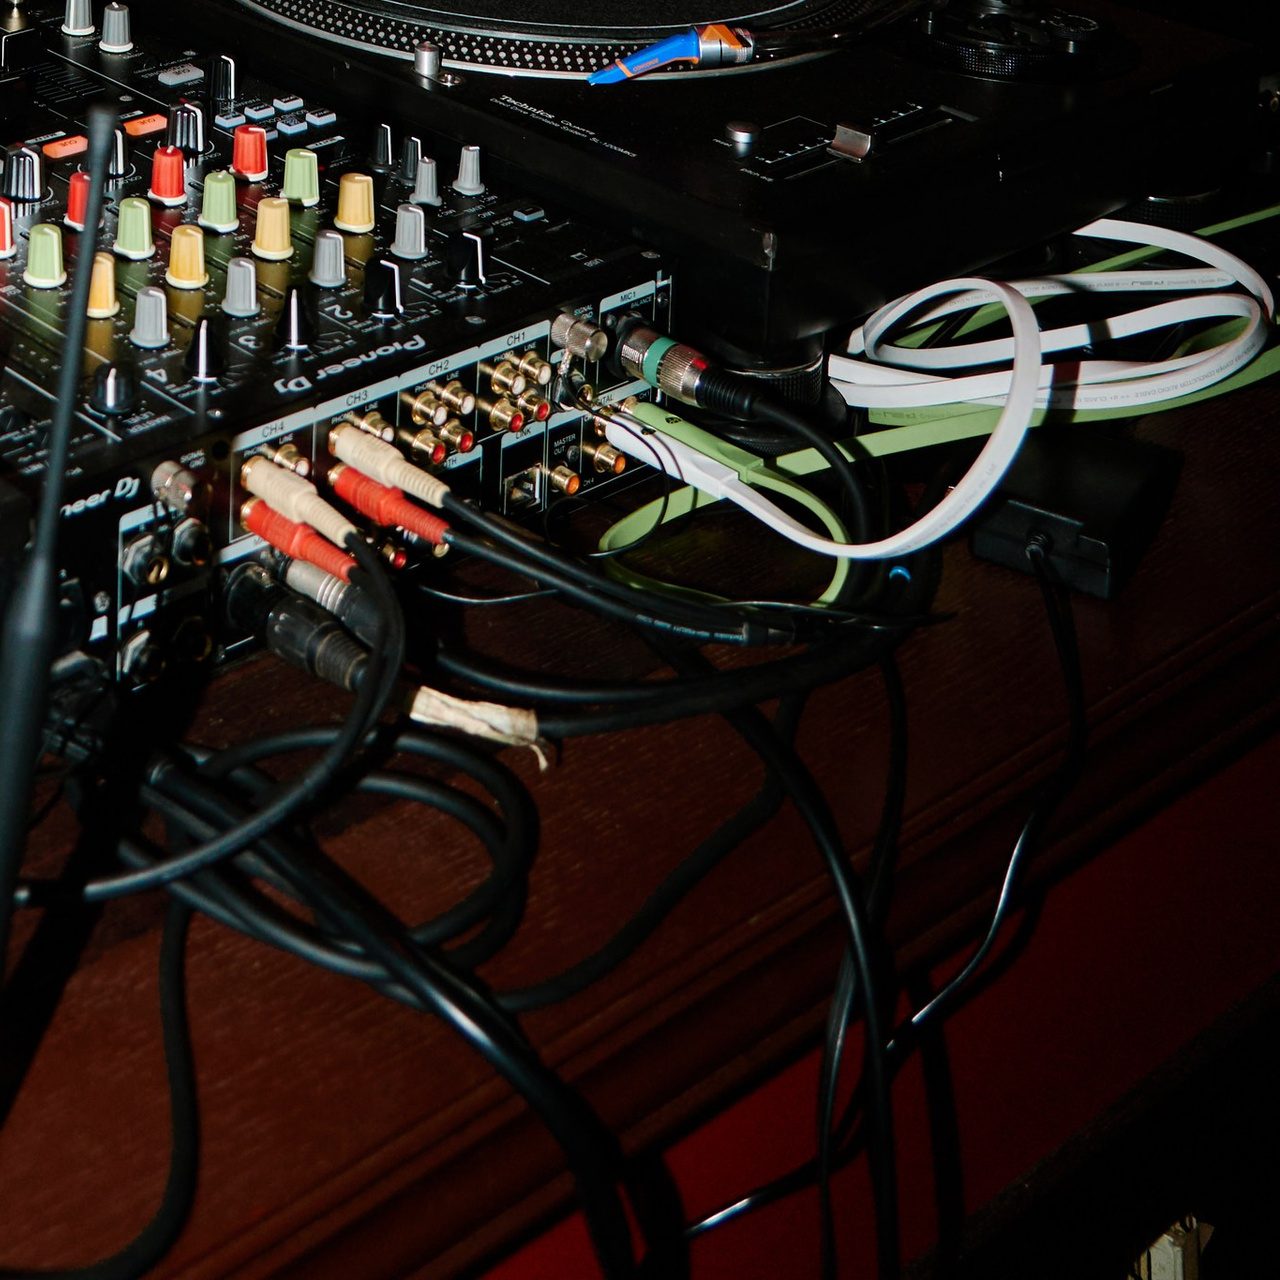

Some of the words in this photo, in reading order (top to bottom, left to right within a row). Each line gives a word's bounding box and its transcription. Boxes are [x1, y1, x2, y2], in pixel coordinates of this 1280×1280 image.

[137, 117, 156, 126] CUE
[58, 139, 77, 148] CUE
[630, 296, 652, 309] BALANCE
[324, 304, 353, 319] 2
[574, 304, 593, 317] SIGNAL
[238, 335, 263, 349] 3
[506, 332, 525, 346] CH1
[524, 341, 537, 351] LINE
[316, 335, 426, 381] Pioneer
[494, 350, 514, 362] PHONO
[428, 360, 449, 376] CH2
[144, 368, 168, 383] 4
[446, 370, 459, 380] LINE
[415, 380, 437, 393] PHONO
[1157, 384, 1178, 394] AUDIO
[346, 391, 368, 406] CH3
[1134, 389, 1156, 398] CABLE
[365, 401, 378, 411] LINE
[123, 411, 155, 426] LEVEL
[261, 422, 284, 437] CH4
[278, 434, 293, 444] LINE
[554, 434, 576, 447] MASTER
[180, 449, 205, 463] SIGNAL
[554, 446, 565, 455] OUT
[190, 458, 205, 469] GND
